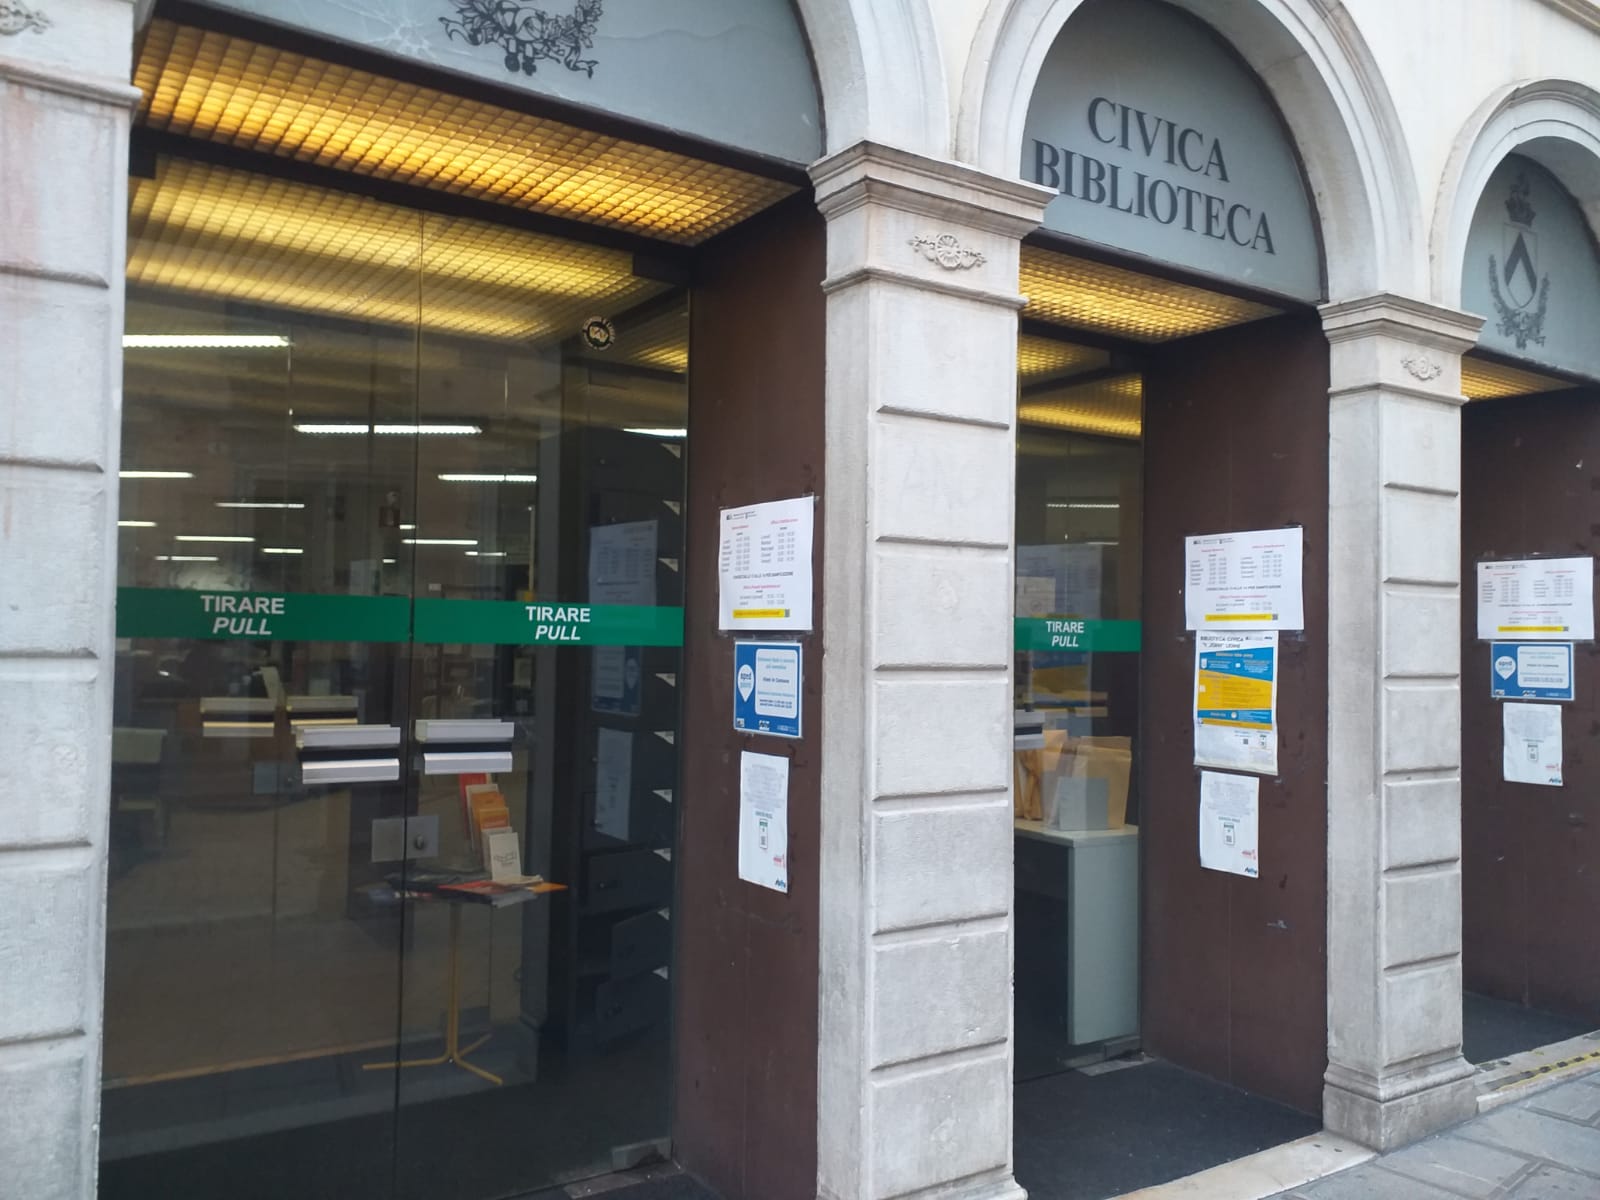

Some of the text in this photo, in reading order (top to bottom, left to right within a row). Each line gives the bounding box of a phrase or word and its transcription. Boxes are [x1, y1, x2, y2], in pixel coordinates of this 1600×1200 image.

[1088, 97, 1230, 182] CIVICA
[1032, 139, 1276, 255] BIBLIOTECA
[200, 595, 285, 615] TIRARE
[525, 605, 591, 622] TIRARE
[212, 617, 272, 635] PULL
[535, 625, 581, 641] PULL
[1046, 620, 1085, 633] TIRARE
[1051, 635, 1079, 647] PULL
